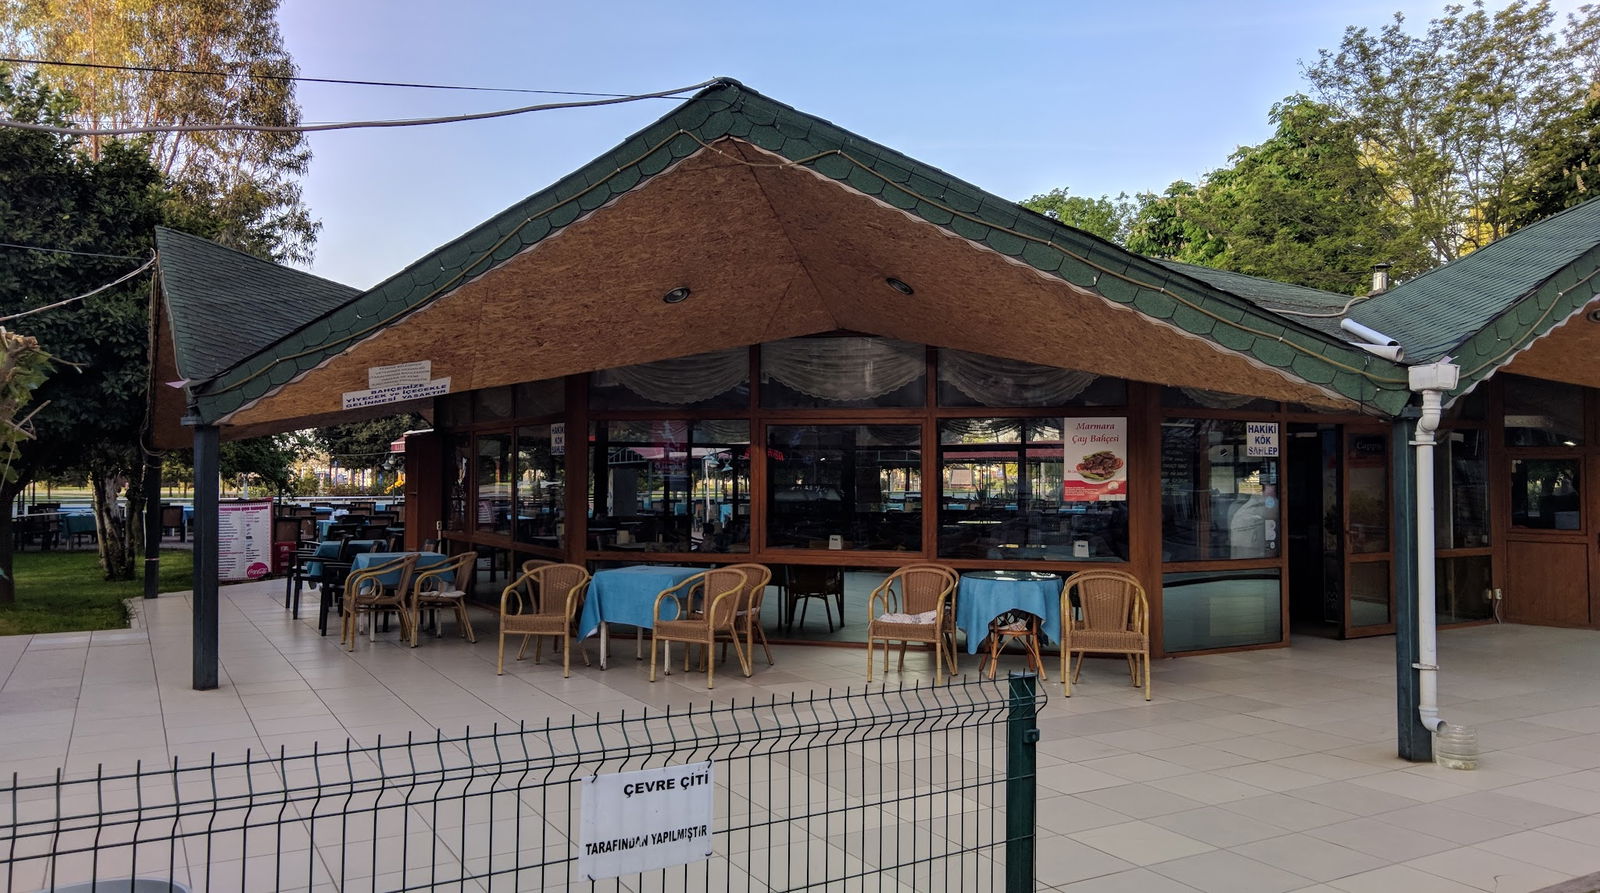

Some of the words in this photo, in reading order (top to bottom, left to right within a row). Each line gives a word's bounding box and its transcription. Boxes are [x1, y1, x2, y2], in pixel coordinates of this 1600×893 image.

[346, 394, 387, 403] YİYECEK
[402, 384, 447, 395] İÇECEKLE
[371, 383, 425, 394] BAHÇEMİZE
[345, 397, 397, 409] GELİNMESİ
[401, 389, 446, 400] YASAKTIR
[1076, 422, 1115, 430] Marmara
[1248, 424, 1277, 434] HAKİKİ
[1072, 435, 1087, 445] Çay
[1090, 434, 1119, 445] Bahçesi
[1254, 435, 1271, 445] KÖK
[1248, 446, 1278, 455] SAHLEP
[623, 778, 676, 798] ÇEVRE
[680, 770, 709, 790] ÇİTİ
[586, 834, 648, 856] TARAFINDAN
[651, 824, 708, 843] YAPILMIŞTIR
